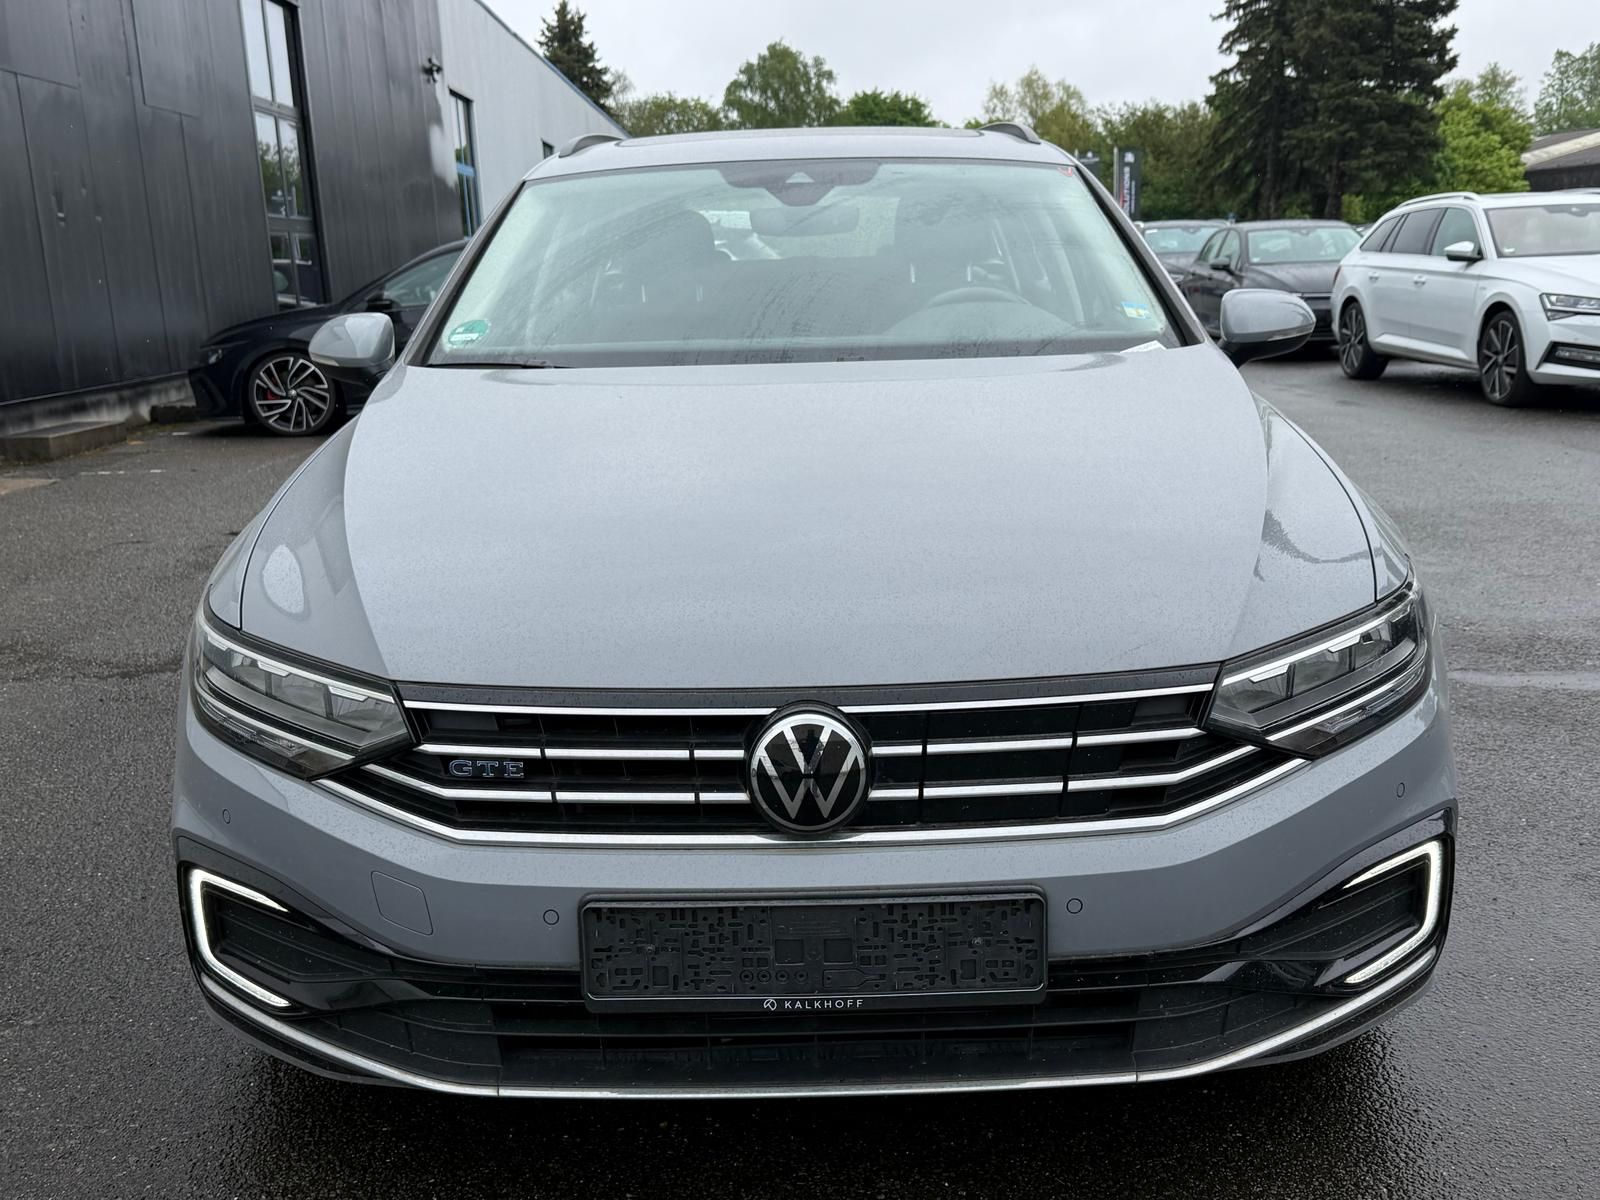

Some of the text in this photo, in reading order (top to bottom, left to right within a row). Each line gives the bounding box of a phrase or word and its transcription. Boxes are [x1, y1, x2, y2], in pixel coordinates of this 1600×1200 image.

[448, 759, 525, 778] GTE
[751, 714, 867, 831] VW
[784, 999, 864, 1010] KALKHOFF
